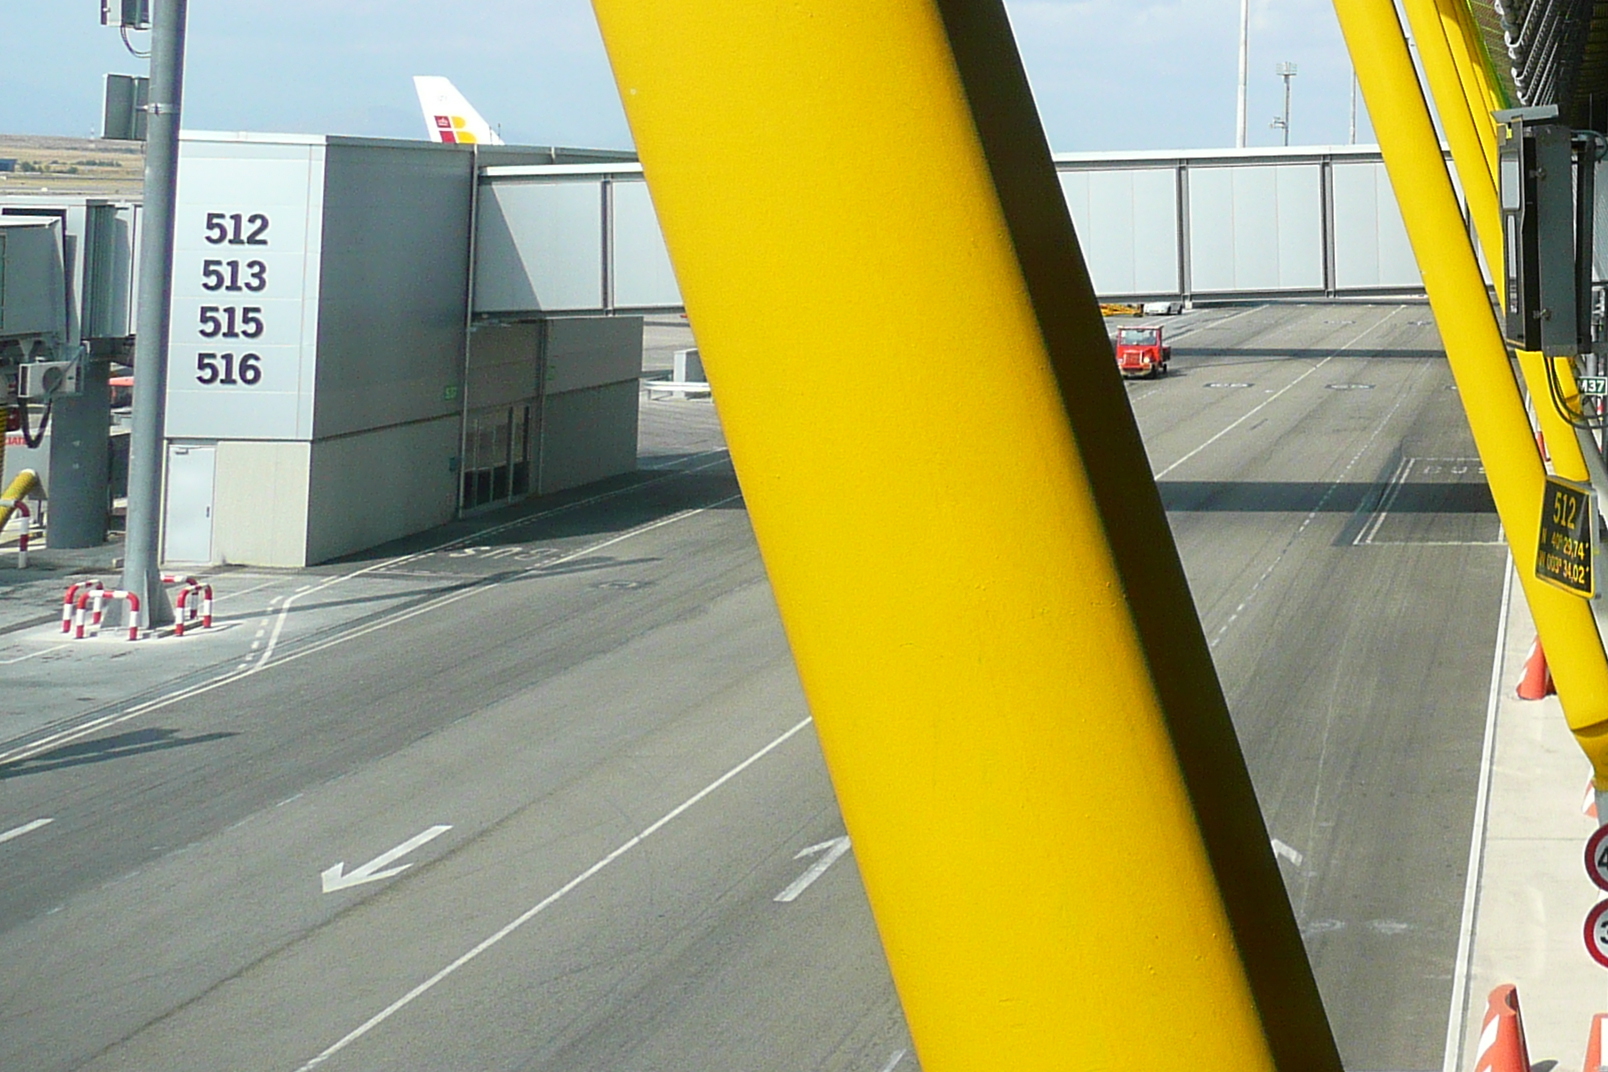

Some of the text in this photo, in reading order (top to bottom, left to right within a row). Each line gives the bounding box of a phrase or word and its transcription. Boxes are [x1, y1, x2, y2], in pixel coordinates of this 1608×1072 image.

[205, 212, 270, 246] 512
[202, 259, 267, 292] 513
[199, 306, 264, 339] 515
[196, 352, 262, 386] 516
[1553, 491, 1577, 530] 512
